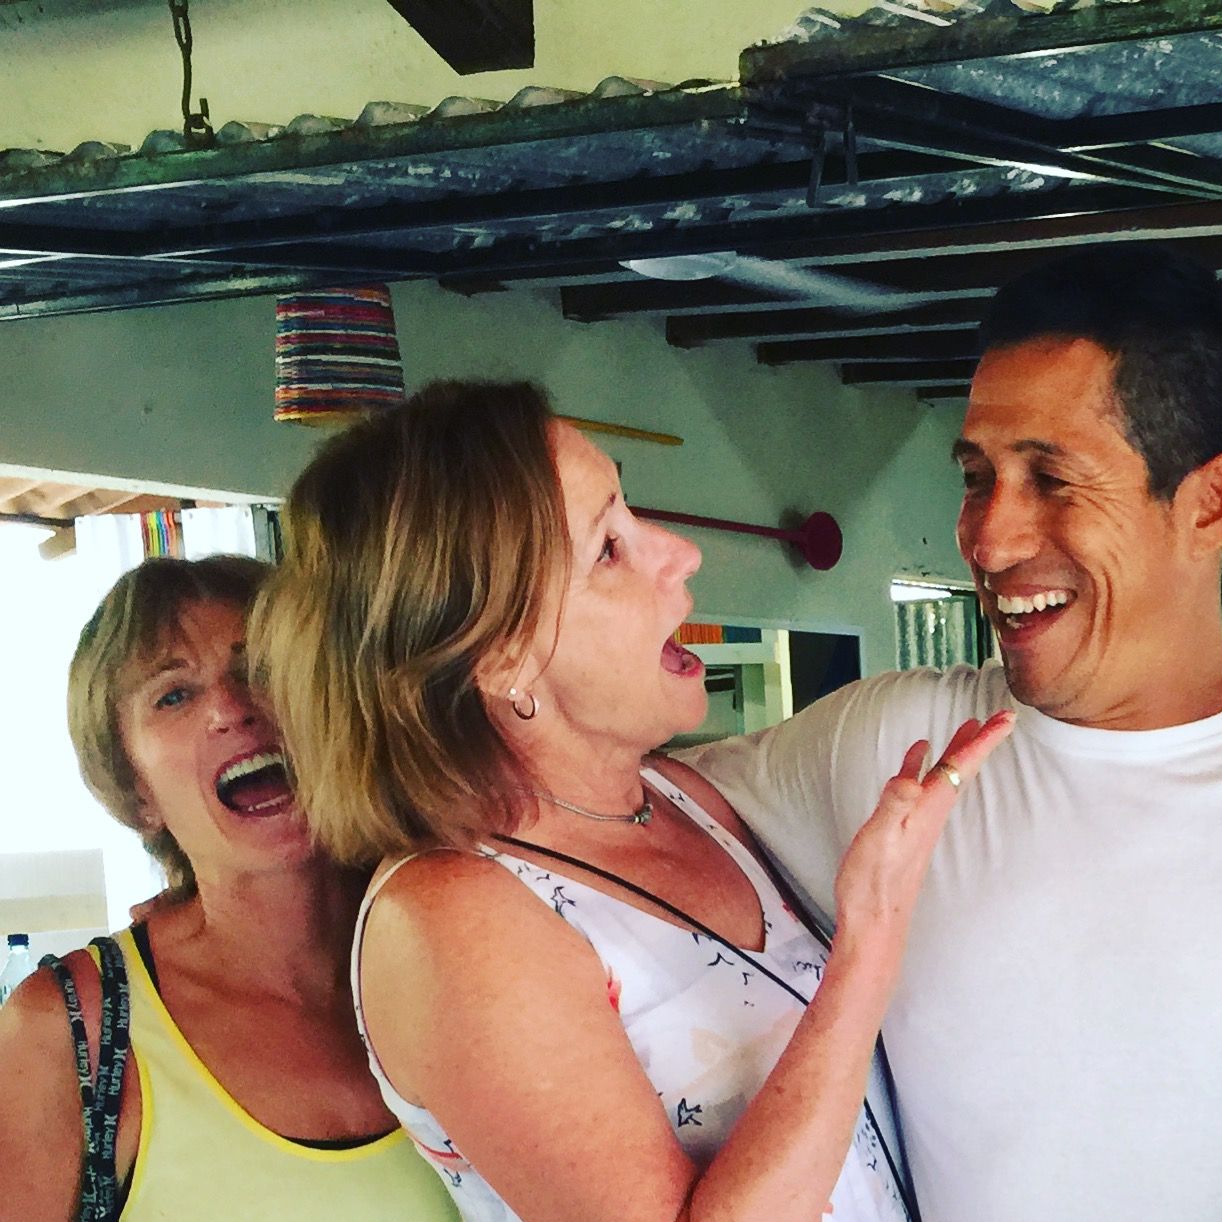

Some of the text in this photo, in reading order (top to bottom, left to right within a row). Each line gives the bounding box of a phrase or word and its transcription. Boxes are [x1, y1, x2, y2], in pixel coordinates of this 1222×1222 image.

[77, 1041, 90, 1075] Hurley
[94, 1077, 108, 1111] Hurley
[108, 1061, 124, 1095] Hurley
[102, 1128, 115, 1159] Hurley
